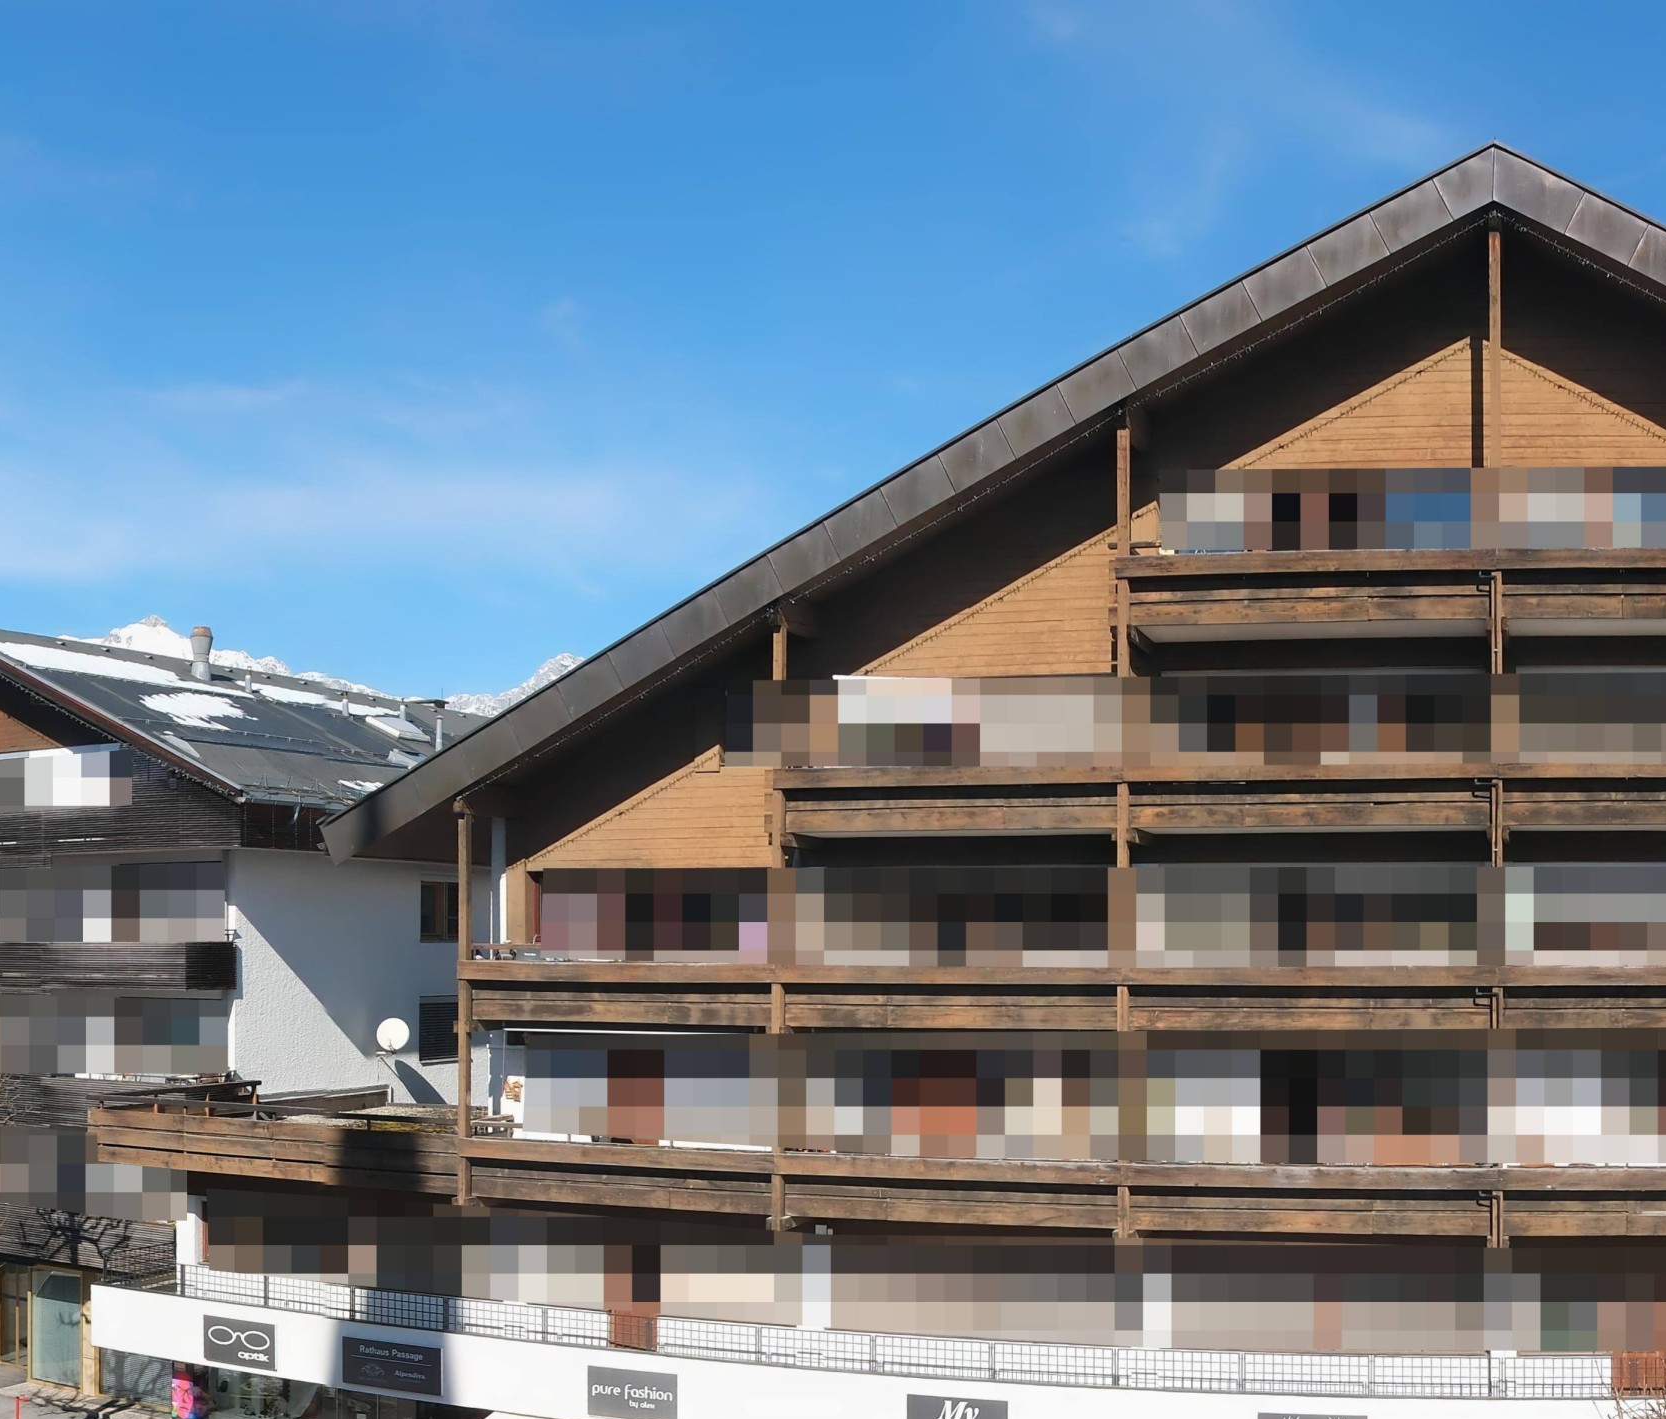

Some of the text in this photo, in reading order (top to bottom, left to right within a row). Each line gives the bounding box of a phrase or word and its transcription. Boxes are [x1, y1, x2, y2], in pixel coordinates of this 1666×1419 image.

[237, 1350, 270, 1363] optik
[359, 1344, 424, 1362] Rathaus Passage
[591, 1383, 673, 1402] pure fashion
[629, 1399, 639, 1409] by
